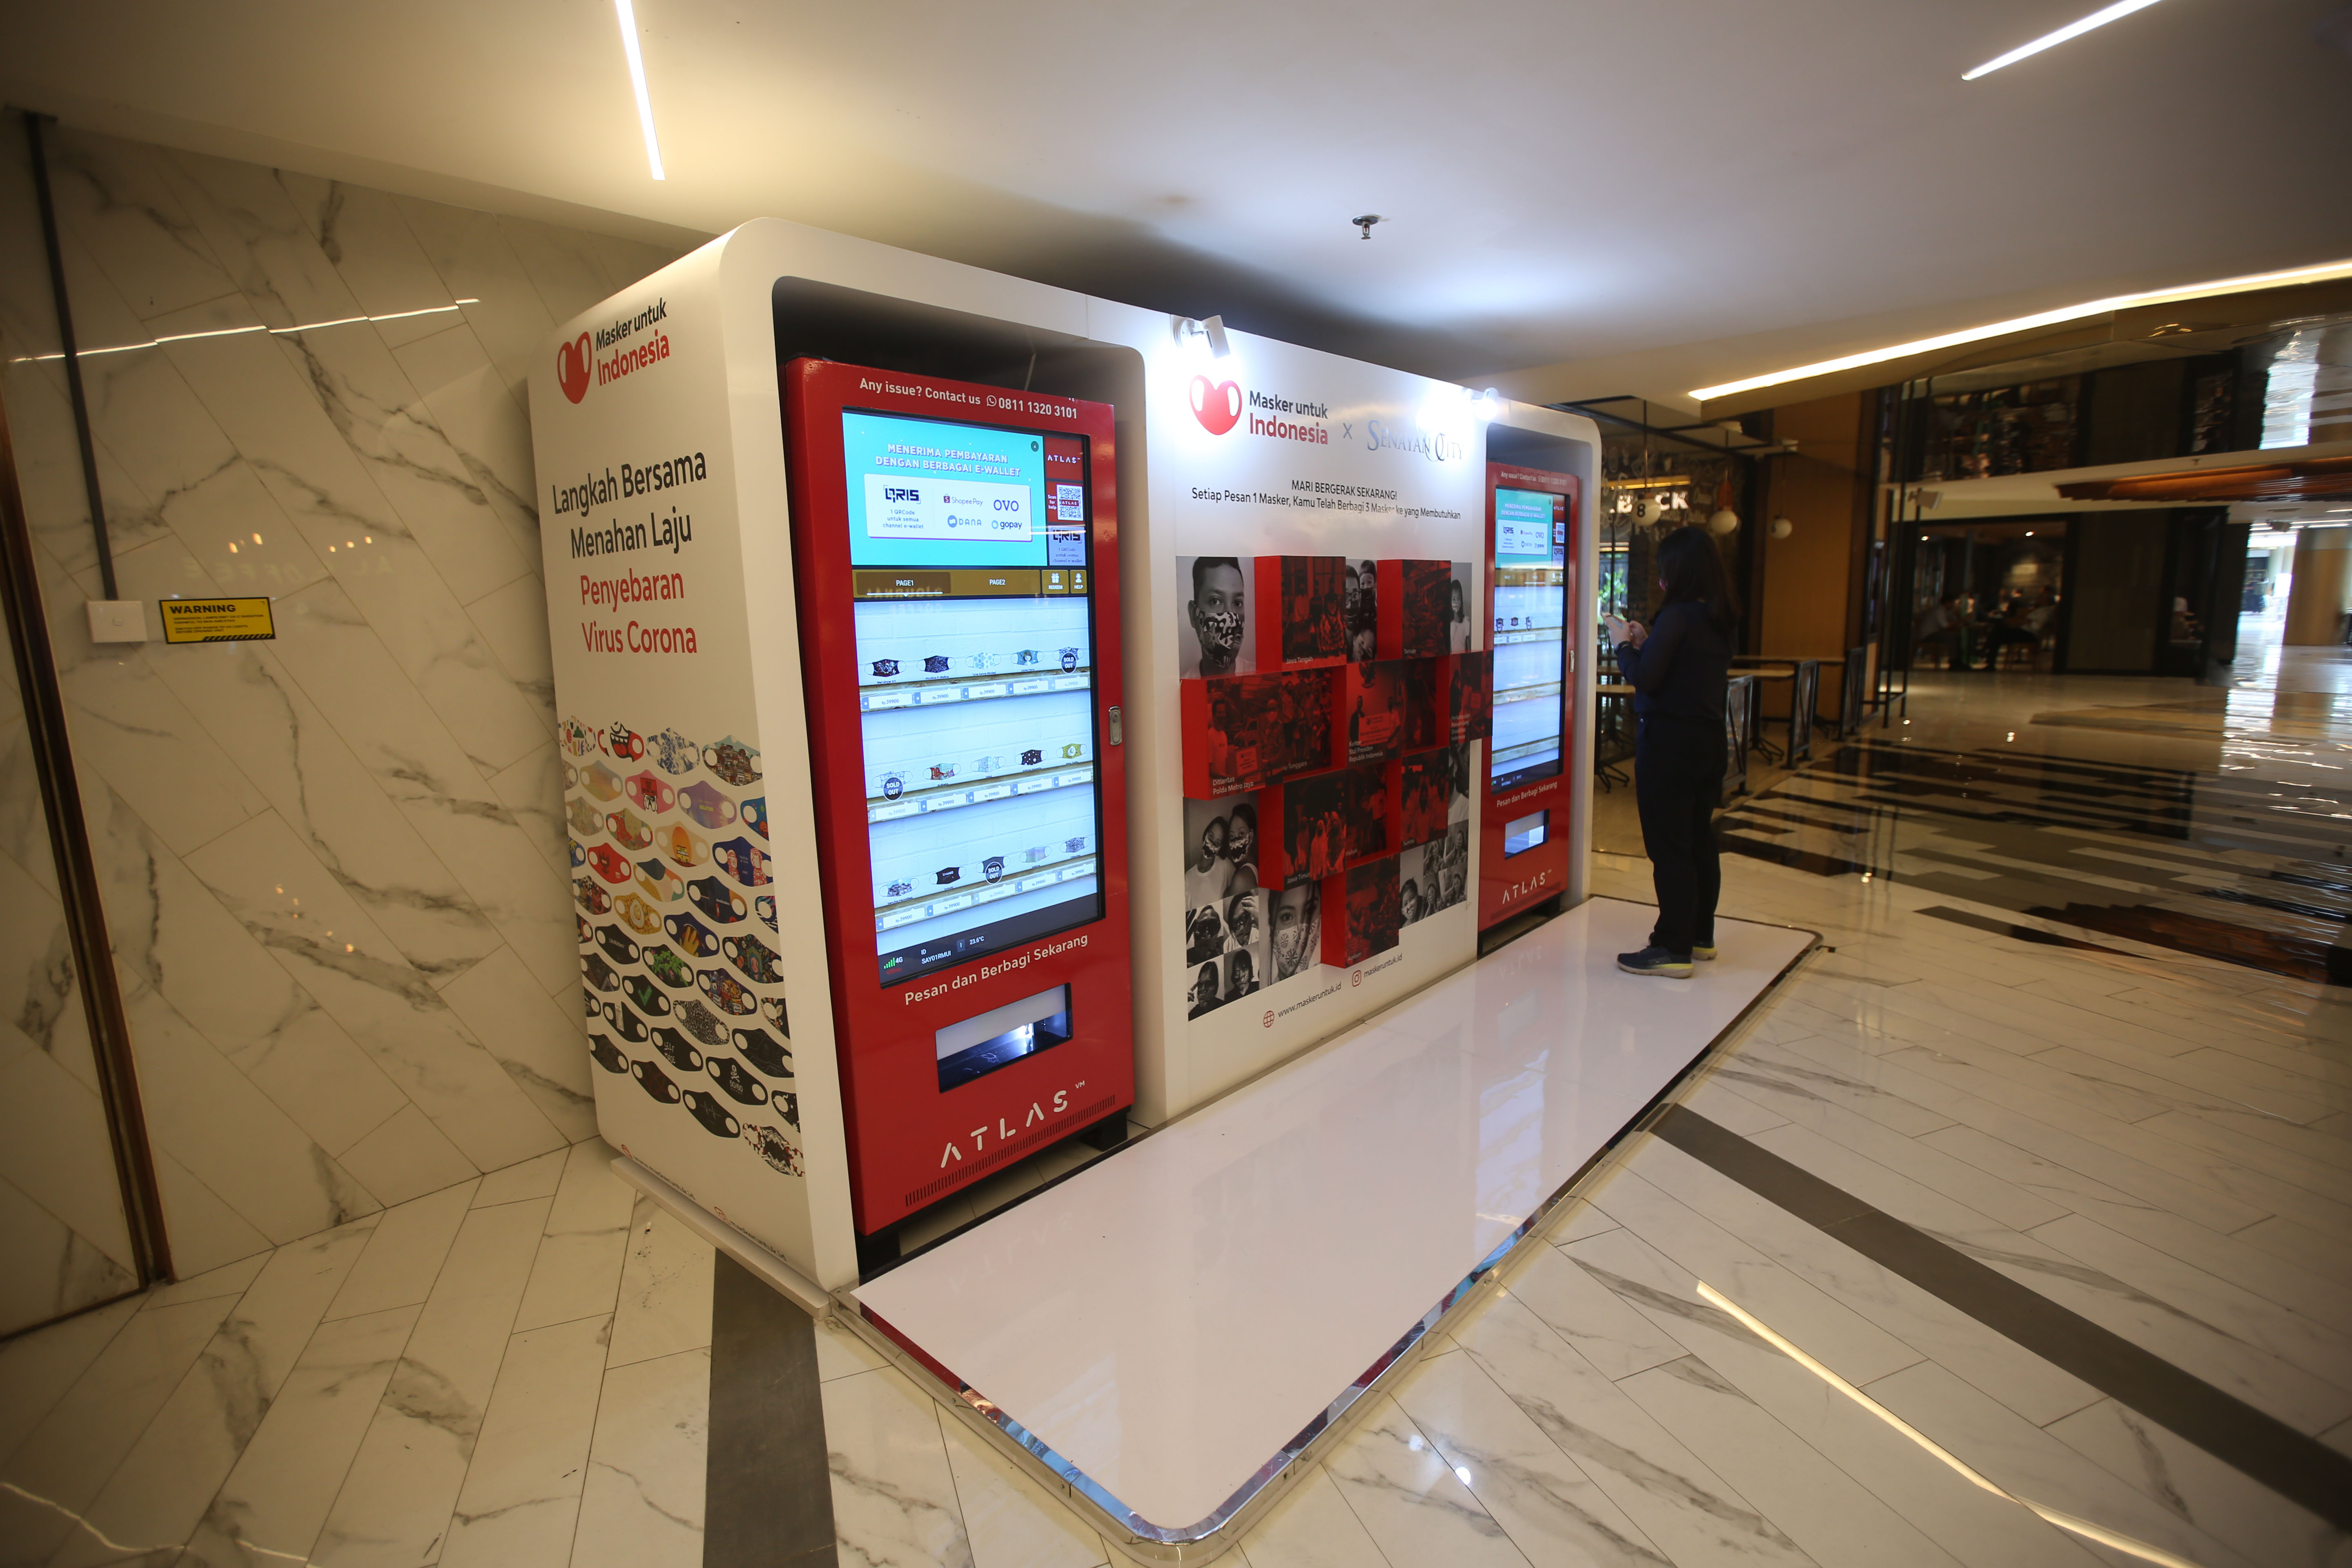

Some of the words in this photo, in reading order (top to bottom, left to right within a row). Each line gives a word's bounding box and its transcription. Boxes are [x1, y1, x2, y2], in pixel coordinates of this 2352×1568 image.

[596, 318, 631, 351] Masker
[632, 297, 667, 331] untuk
[597, 330, 670, 386] Indonesia
[860, 378, 882, 393] Any
[886, 381, 922, 396] issue?
[925, 388, 966, 403] Contact
[969, 395, 980, 405] us
[999, 398, 1023, 411] 0811
[1028, 402, 1051, 415] 1320
[1054, 405, 1077, 419] 3101
[1250, 390, 1293, 414] Masker
[1296, 401, 1328, 420] untuk
[1250, 413, 1328, 445] Indonesia
[875, 456, 920, 468] DENGAN
[923, 461, 973, 473] BERBAGAI
[976, 465, 1021, 477] E-WALLET
[888, 444, 942, 457] MENERIMA
[945, 450, 1008, 463] PEMBAYARAN
[1047, 454, 1076, 463] ATLAS
[552, 468, 618, 517] Langkah
[622, 452, 707, 498] Bersama
[1292, 480, 1313, 492] MARI
[1315, 482, 1355, 497] BERGERAK
[1356, 486, 1397, 500] SEKARANG!
[993, 499, 1019, 511] OVO
[1192, 487, 1222, 503] Setiap
[1224, 490, 1251, 503] Pesan
[1253, 493, 1257, 503] 1
[1259, 493, 1291, 508] Masker,
[1293, 496, 1315, 508] Kamu
[1316, 498, 1336, 510] Telah
[1337, 499, 1364, 514] Berbagi
[1365, 502, 1370, 512] 3
[1395, 504, 1403, 515] ke
[1404, 507, 1419, 519] yang
[1420, 507, 1461, 520] Membutuhkan
[570, 519, 646, 558] Menahan
[651, 506, 692, 554] Laju
[959, 518, 982, 526] DANA
[1000, 521, 1022, 530] gopay
[580, 568, 684, 612] Penyebaran
[169, 604, 236, 614] WARNING
[582, 622, 624, 653] Virus
[627, 621, 697, 654] Corona
[1349, 753, 1365, 762] Republik
[1213, 777, 1235, 786] Ditlantas
[1213, 786, 1227, 795] Polda
[1228, 783, 1243, 791] Metro
[1497, 799, 1510, 807] Pesan
[1512, 794, 1520, 803] dan
[1521, 786, 1538, 800] Berbagi
[1539, 781, 1557, 793] Sekarang
[1503, 872, 1546, 904] ATLAS
[969, 936, 984, 945] 23.6°C
[905, 982, 948, 1005] Pesan
[952, 971, 977, 990] dan
[981, 951, 1031, 979] Berbagi
[1033, 934, 1088, 960] Sekarang
[1364, 953, 1402, 978] maskeruntuk.id
[1278, 982, 1341, 1018] www.maskeruntuk.id
[664, 1042, 675, 1053] SELF
[941, 1090, 1068, 1168] ATLAS
